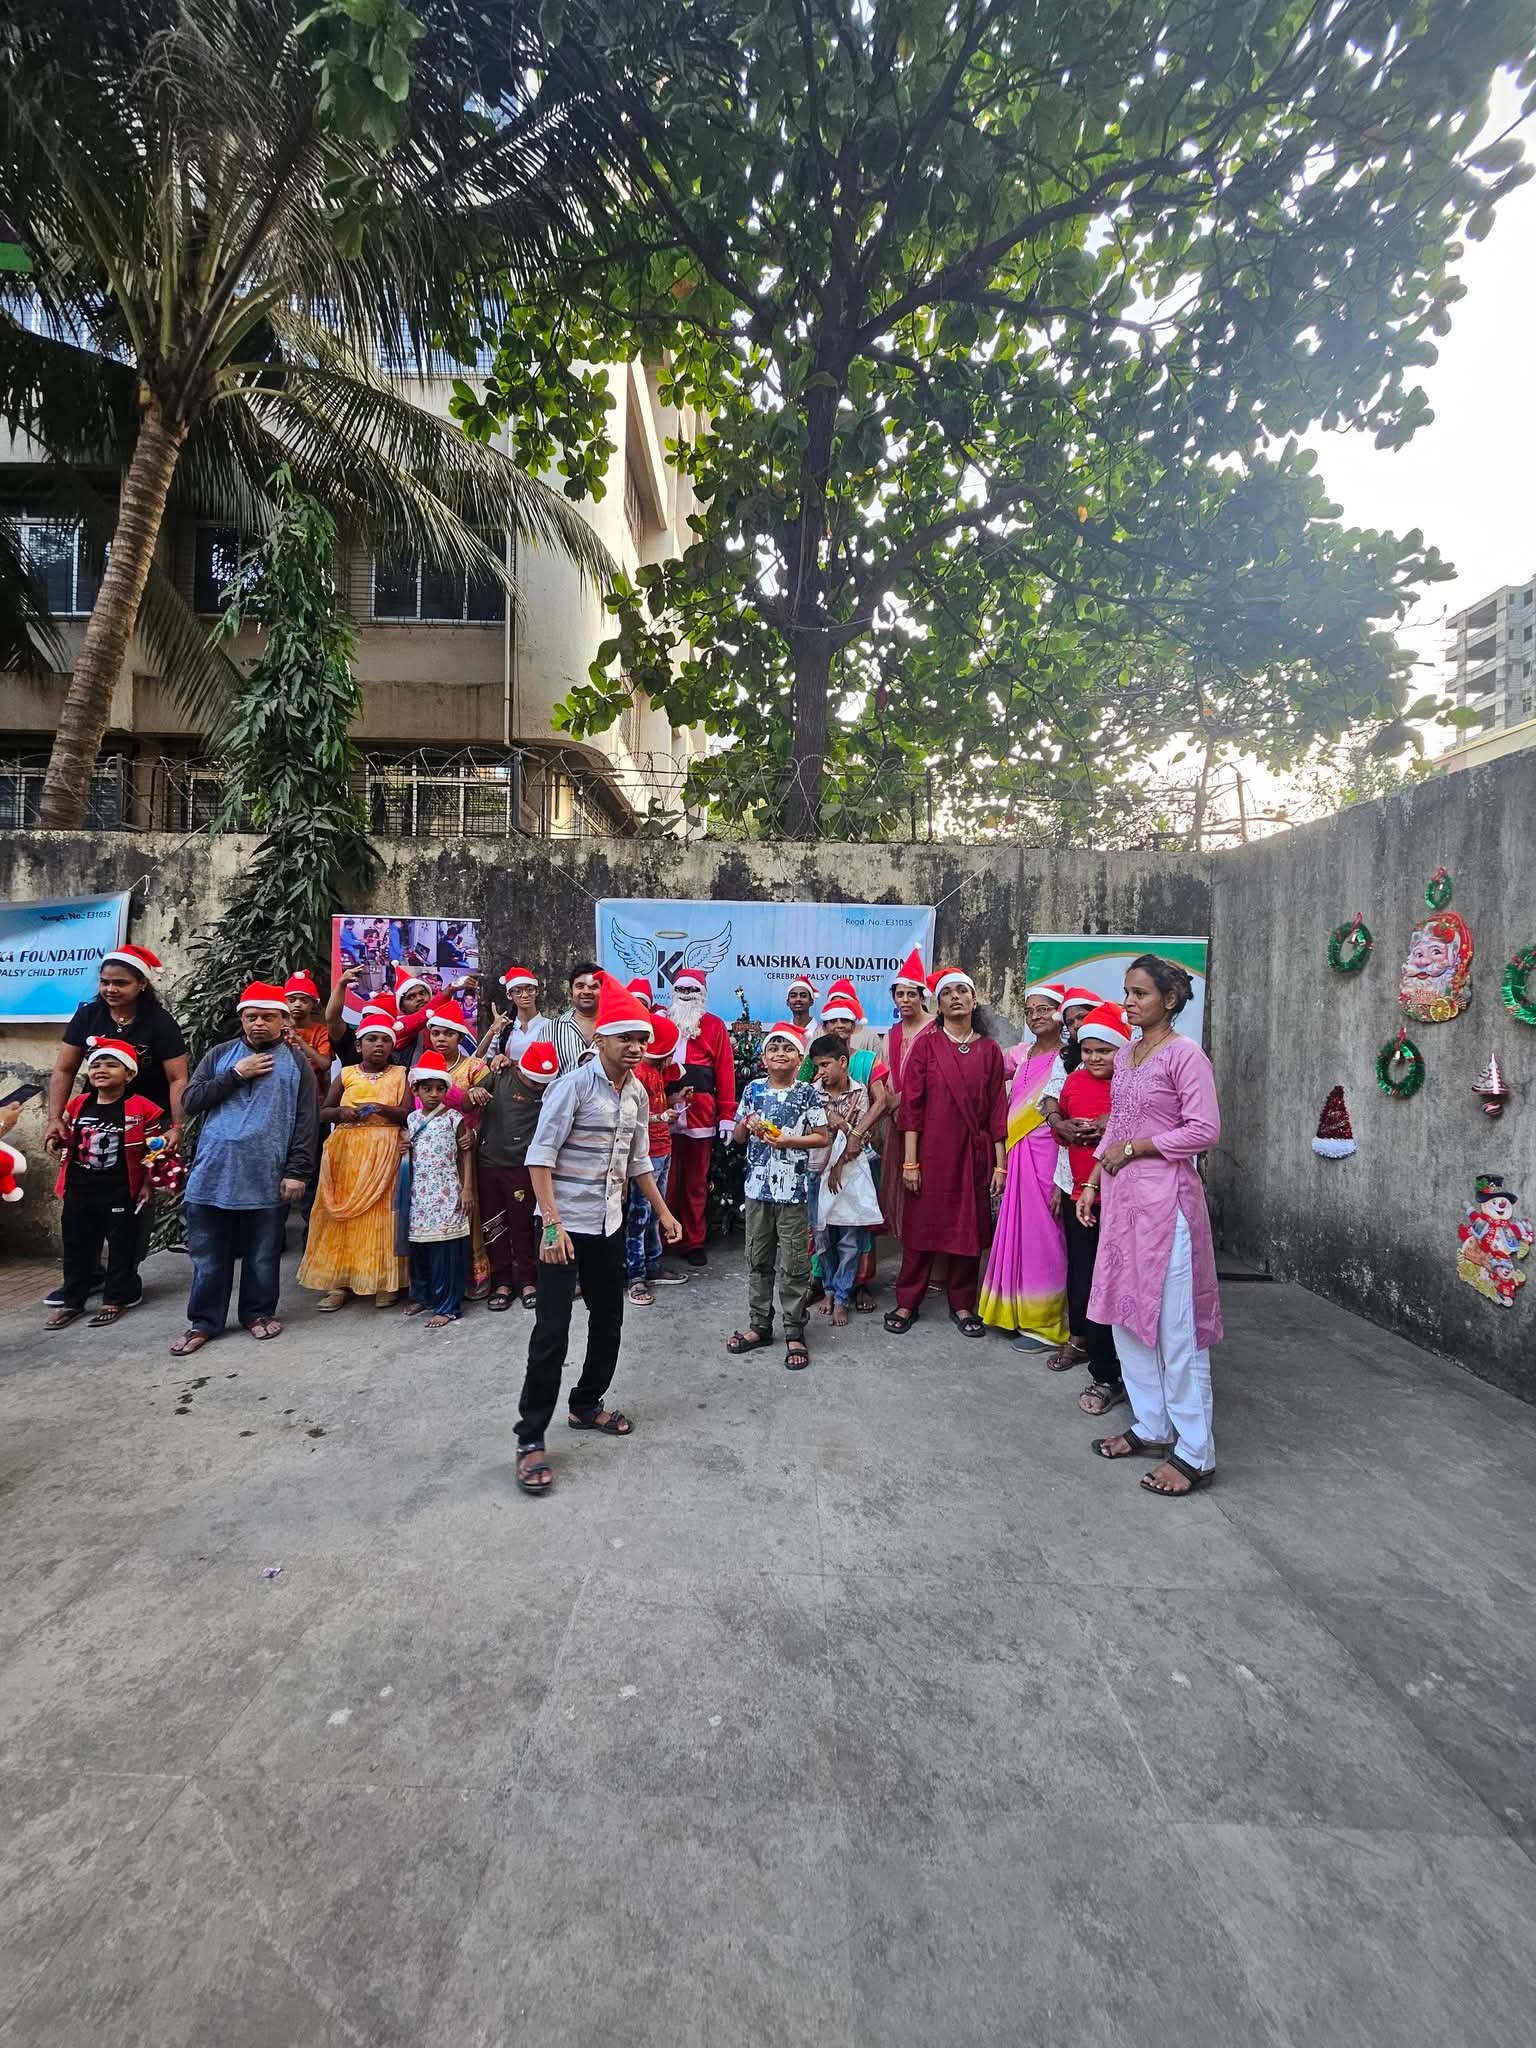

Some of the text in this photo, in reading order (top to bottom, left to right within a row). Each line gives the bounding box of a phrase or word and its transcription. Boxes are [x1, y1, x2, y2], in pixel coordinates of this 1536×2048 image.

[87, 910, 111, 918] E31035
[736, 954, 811, 969] KANISHKA
[28, 968, 55, 977] CHILD
